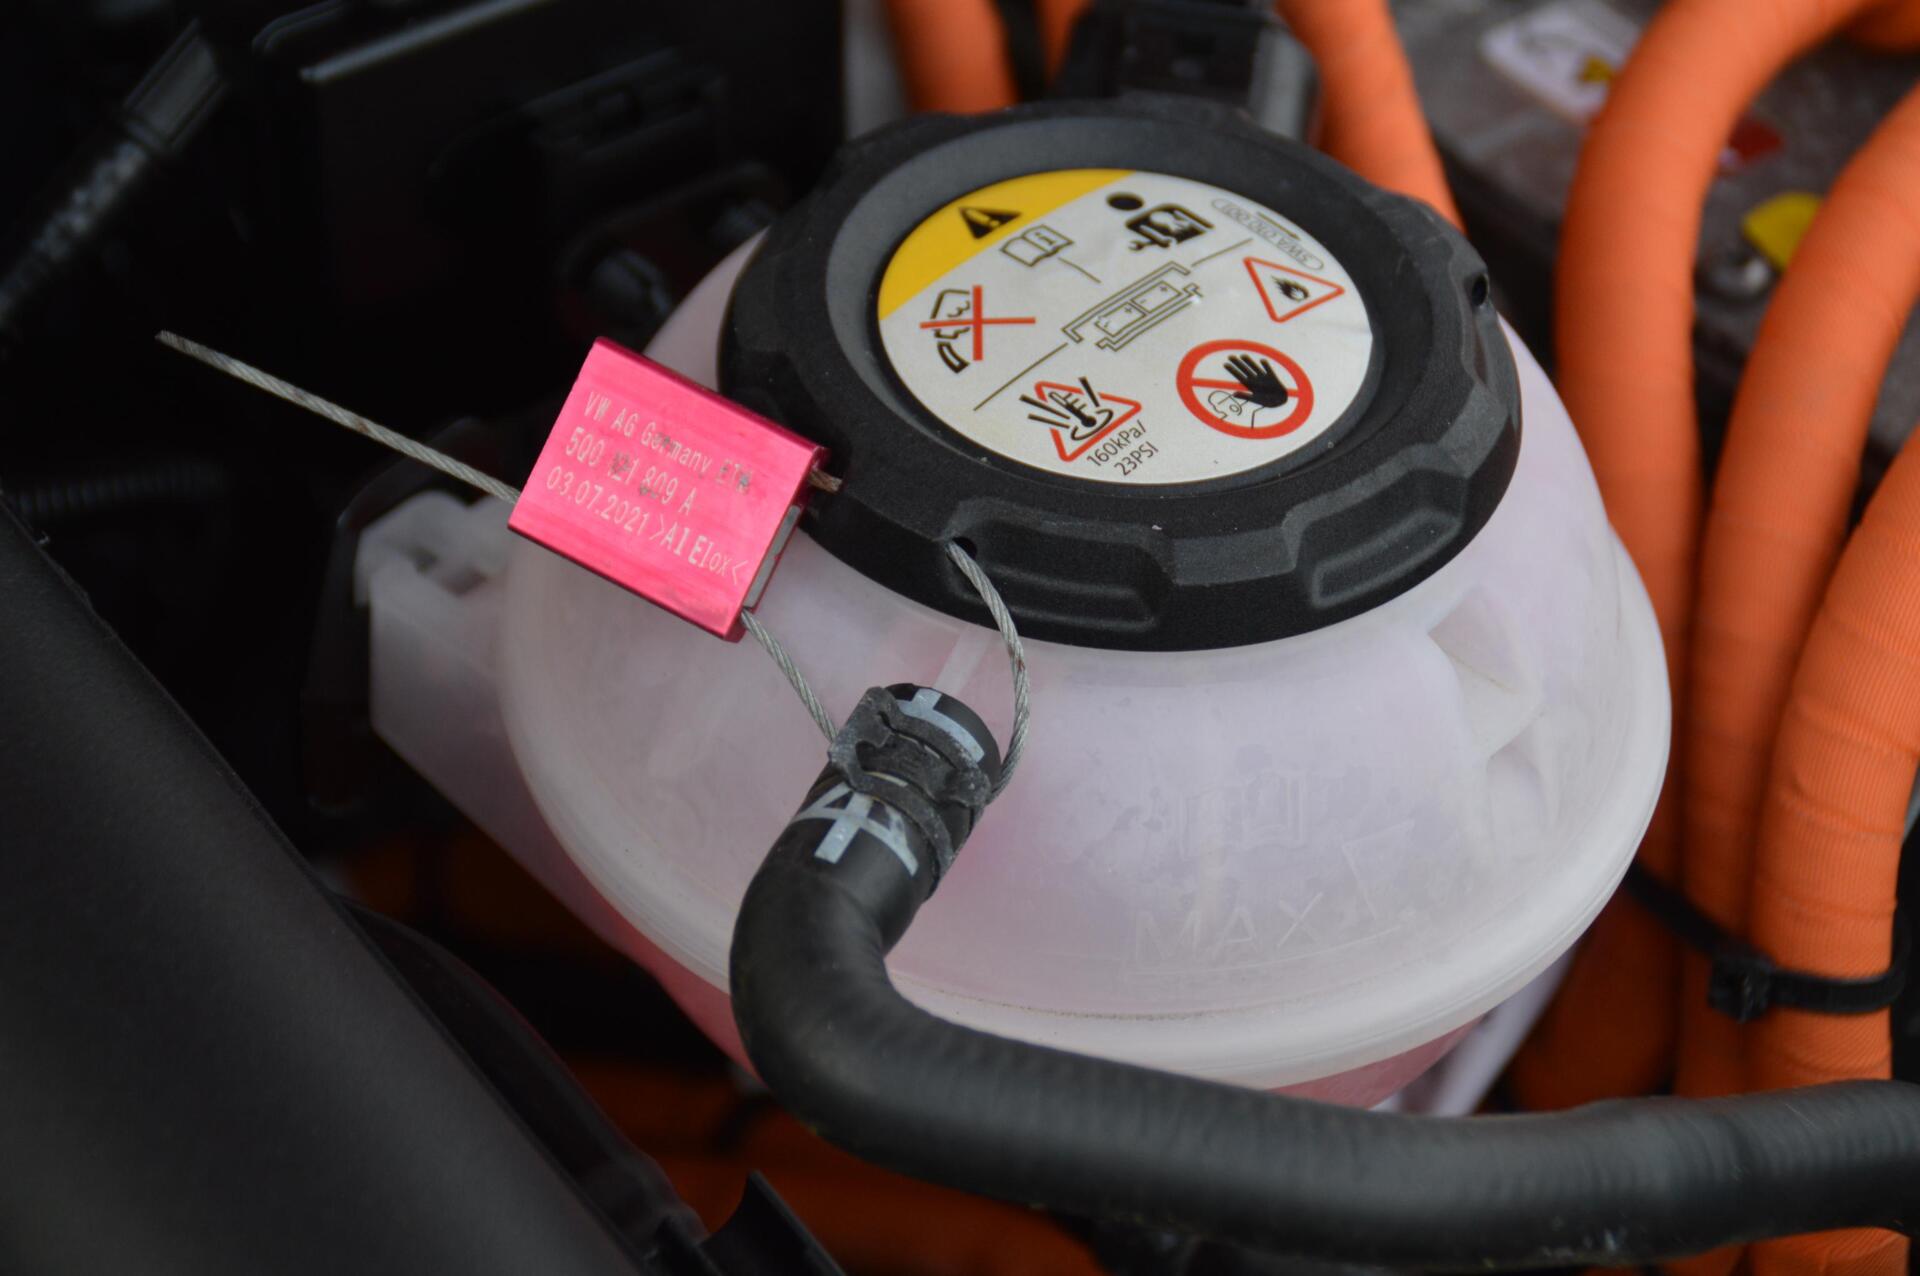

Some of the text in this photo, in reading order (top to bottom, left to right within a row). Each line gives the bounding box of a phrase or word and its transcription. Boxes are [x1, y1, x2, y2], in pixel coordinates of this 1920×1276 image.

[583, 391, 611, 423] VW
[611, 407, 640, 438] AG
[640, 421, 713, 475] Germany
[1086, 419, 1147, 467] 160kPa/
[1113, 440, 1159, 477] 23PSI
[546, 465, 649, 536] 03.07.2021
[638, 465, 680, 505] 809
[677, 487, 698, 517] A
[1136, 891, 1326, 962] MAX
